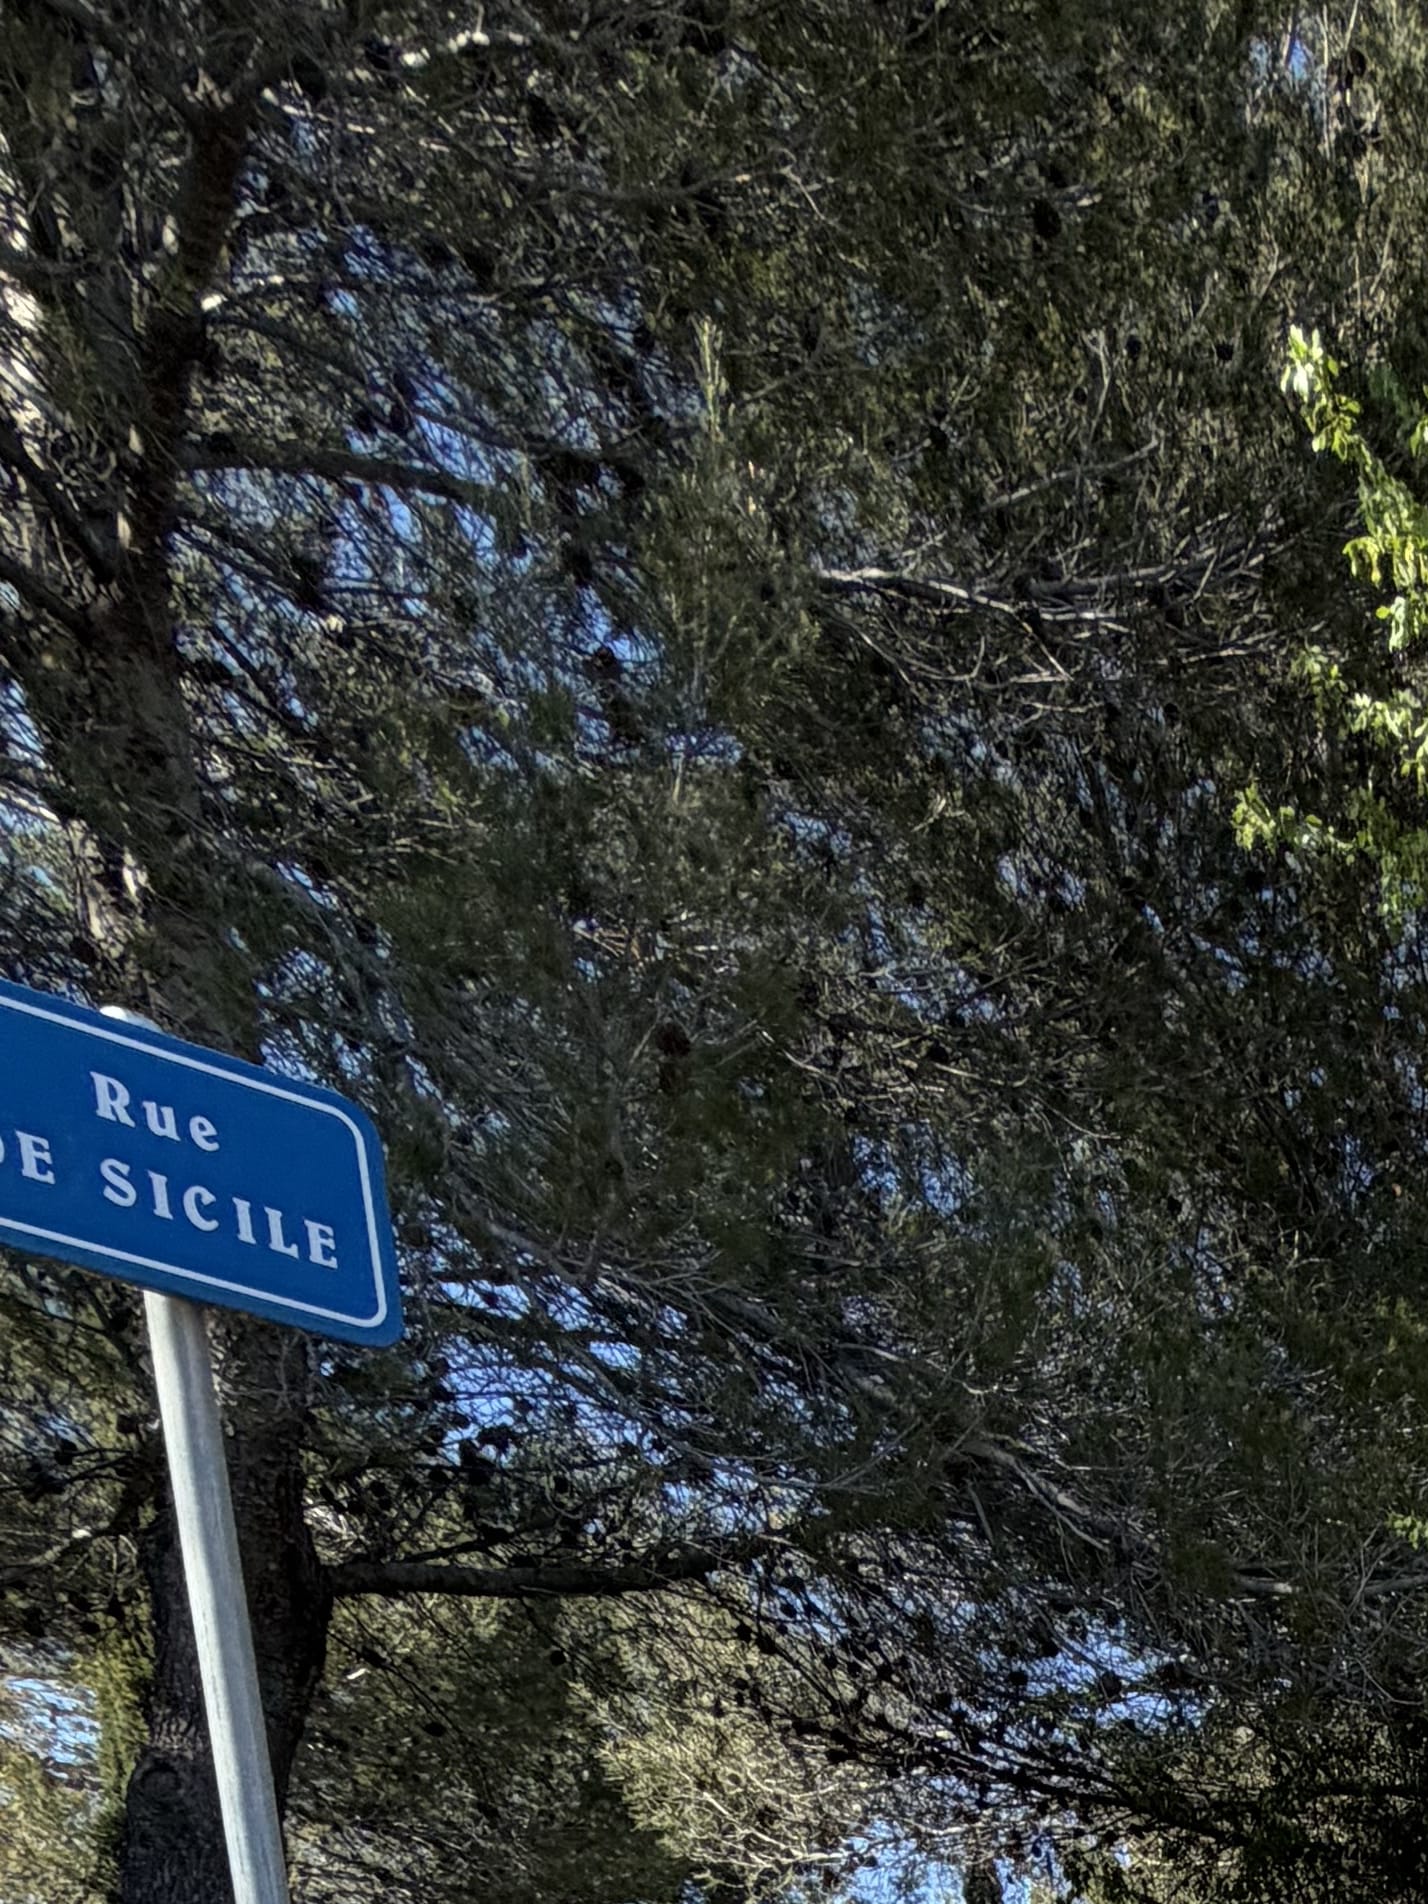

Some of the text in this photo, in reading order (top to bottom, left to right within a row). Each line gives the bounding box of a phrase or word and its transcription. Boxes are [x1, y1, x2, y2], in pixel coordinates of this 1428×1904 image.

[91, 1071, 220, 1152] Rue
[0, 1130, 338, 1269] E SICILE
